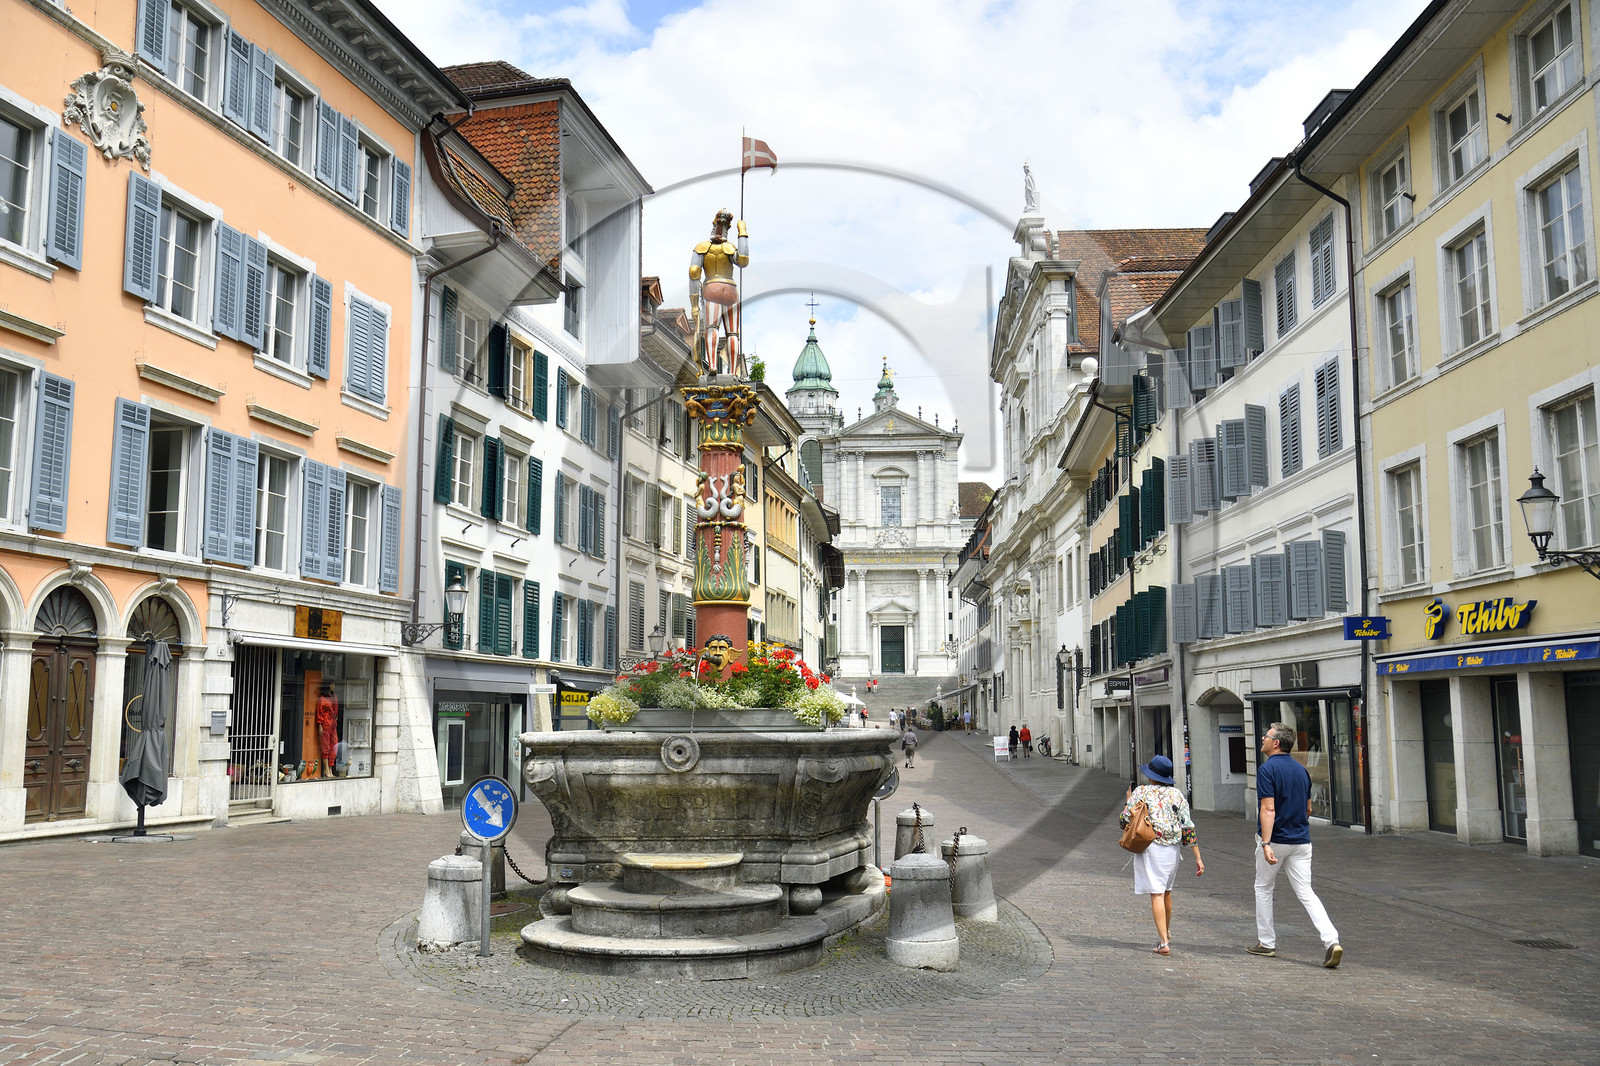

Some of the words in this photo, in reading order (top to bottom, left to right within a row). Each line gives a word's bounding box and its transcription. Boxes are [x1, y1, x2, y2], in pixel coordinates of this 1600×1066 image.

[1456, 597, 1533, 635] Tchibo
[1353, 629, 1382, 637] Tchibo
[1554, 648, 1579, 660] Tchibo
[1466, 656, 1484, 666] Tchibo
